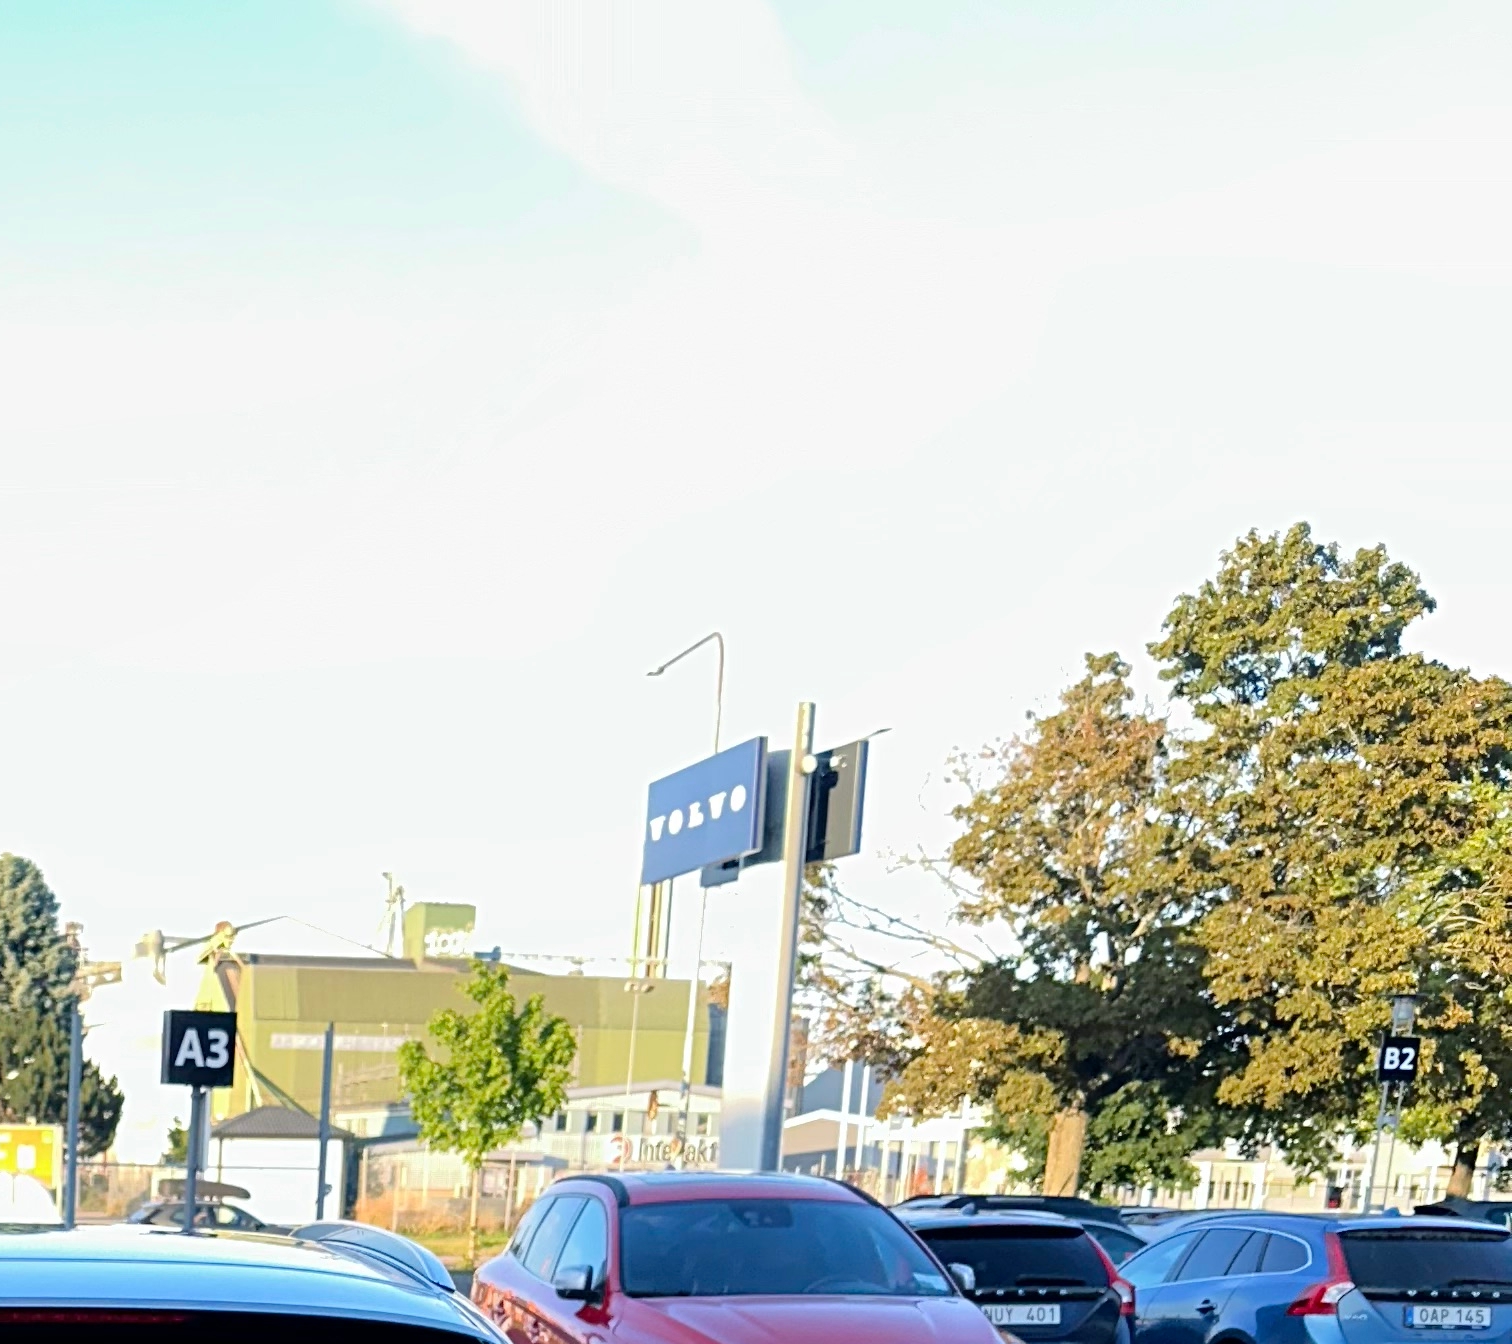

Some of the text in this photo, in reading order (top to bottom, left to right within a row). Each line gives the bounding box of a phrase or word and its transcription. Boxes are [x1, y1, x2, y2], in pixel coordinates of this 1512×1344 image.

[649, 783, 747, 842] VOLVO
[174, 1028, 229, 1068] A3
[1384, 1046, 1416, 1070] B2
[1027, 1307, 1056, 1322] 401
[1419, 1308, 1485, 1324] OAP 145
